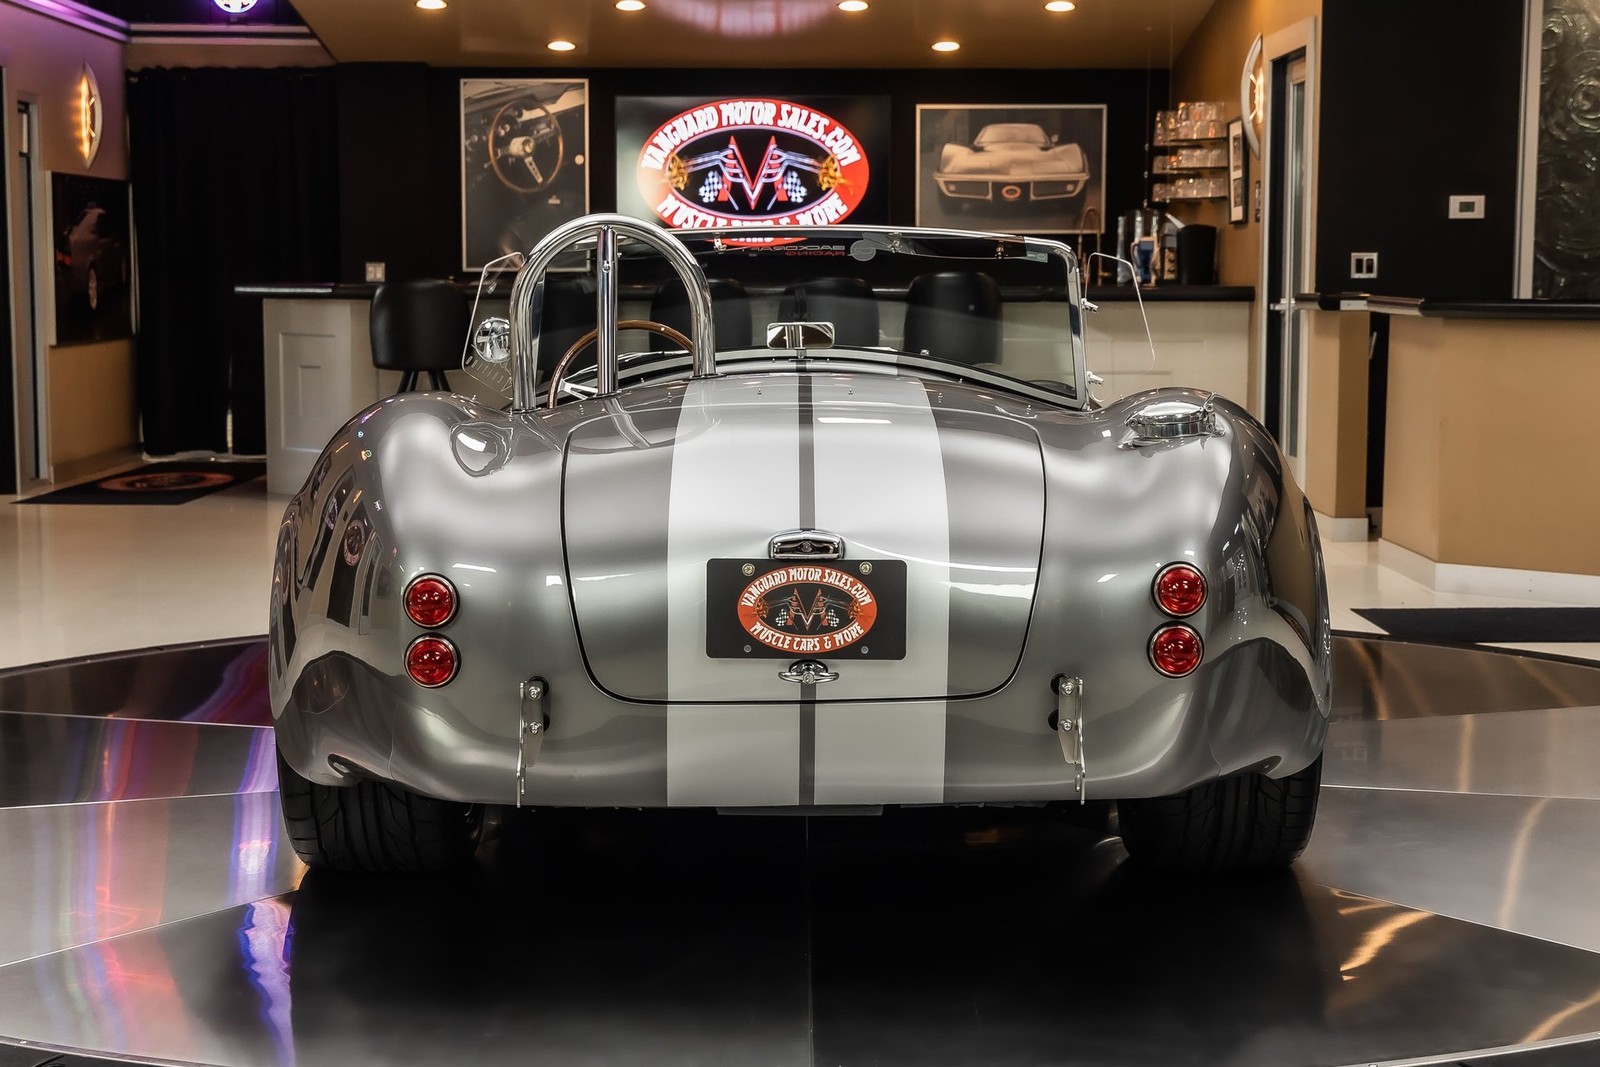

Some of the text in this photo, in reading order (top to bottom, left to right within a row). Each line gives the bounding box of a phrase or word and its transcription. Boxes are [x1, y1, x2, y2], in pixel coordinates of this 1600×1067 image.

[641, 101, 862, 171] VANGUARD MOTOR SALES.COM
[741, 568, 873, 607] VANGUARD MOTOR SALES.COM
[749, 622, 865, 652] MUSCLE CARS & MORE
